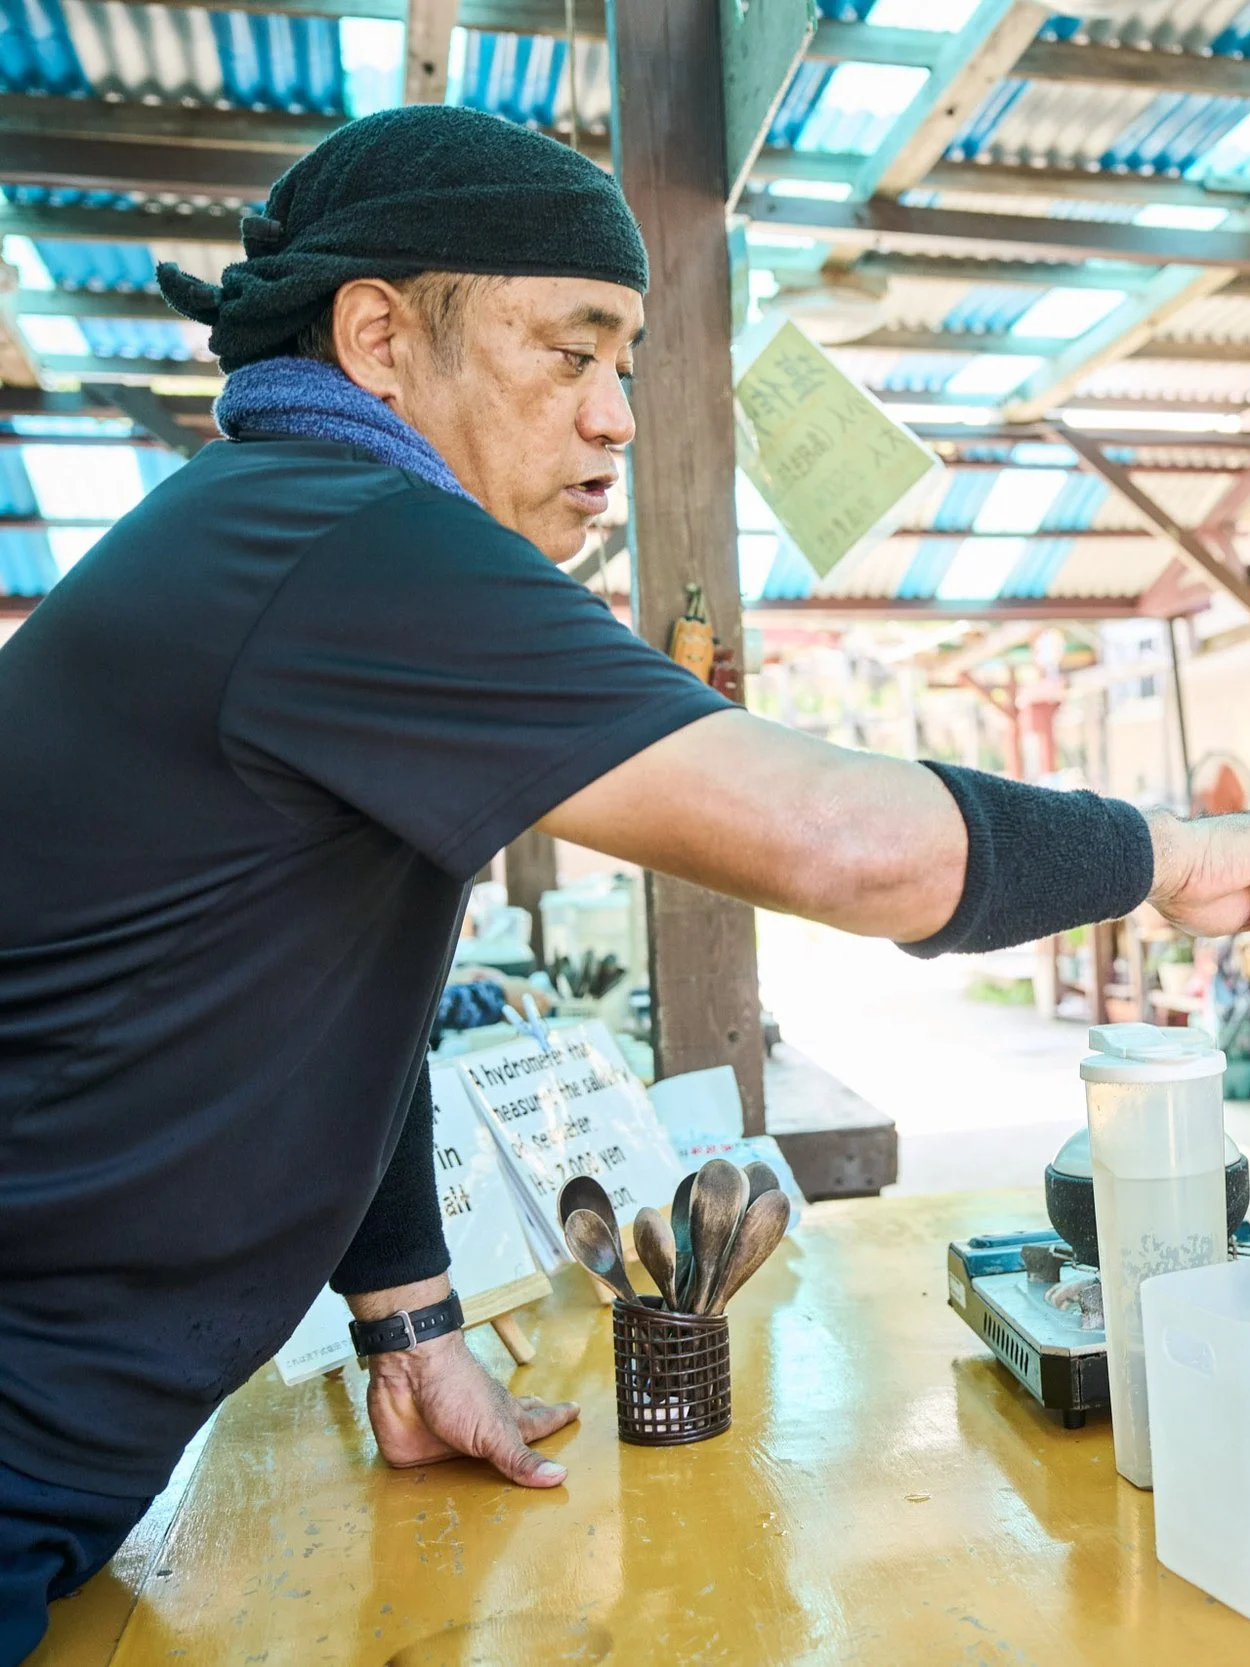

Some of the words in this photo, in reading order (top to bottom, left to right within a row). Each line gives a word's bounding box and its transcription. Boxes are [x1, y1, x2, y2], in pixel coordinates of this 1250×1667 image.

[480, 1049, 564, 1085] hydrometer
[566, 1042, 592, 1062] tha
[493, 1086, 559, 1123] measurs
[557, 1077, 582, 1101] the
[528, 1170, 557, 1197] Its
[600, 1145, 626, 1172] yen
[443, 1184, 473, 1217] alt
